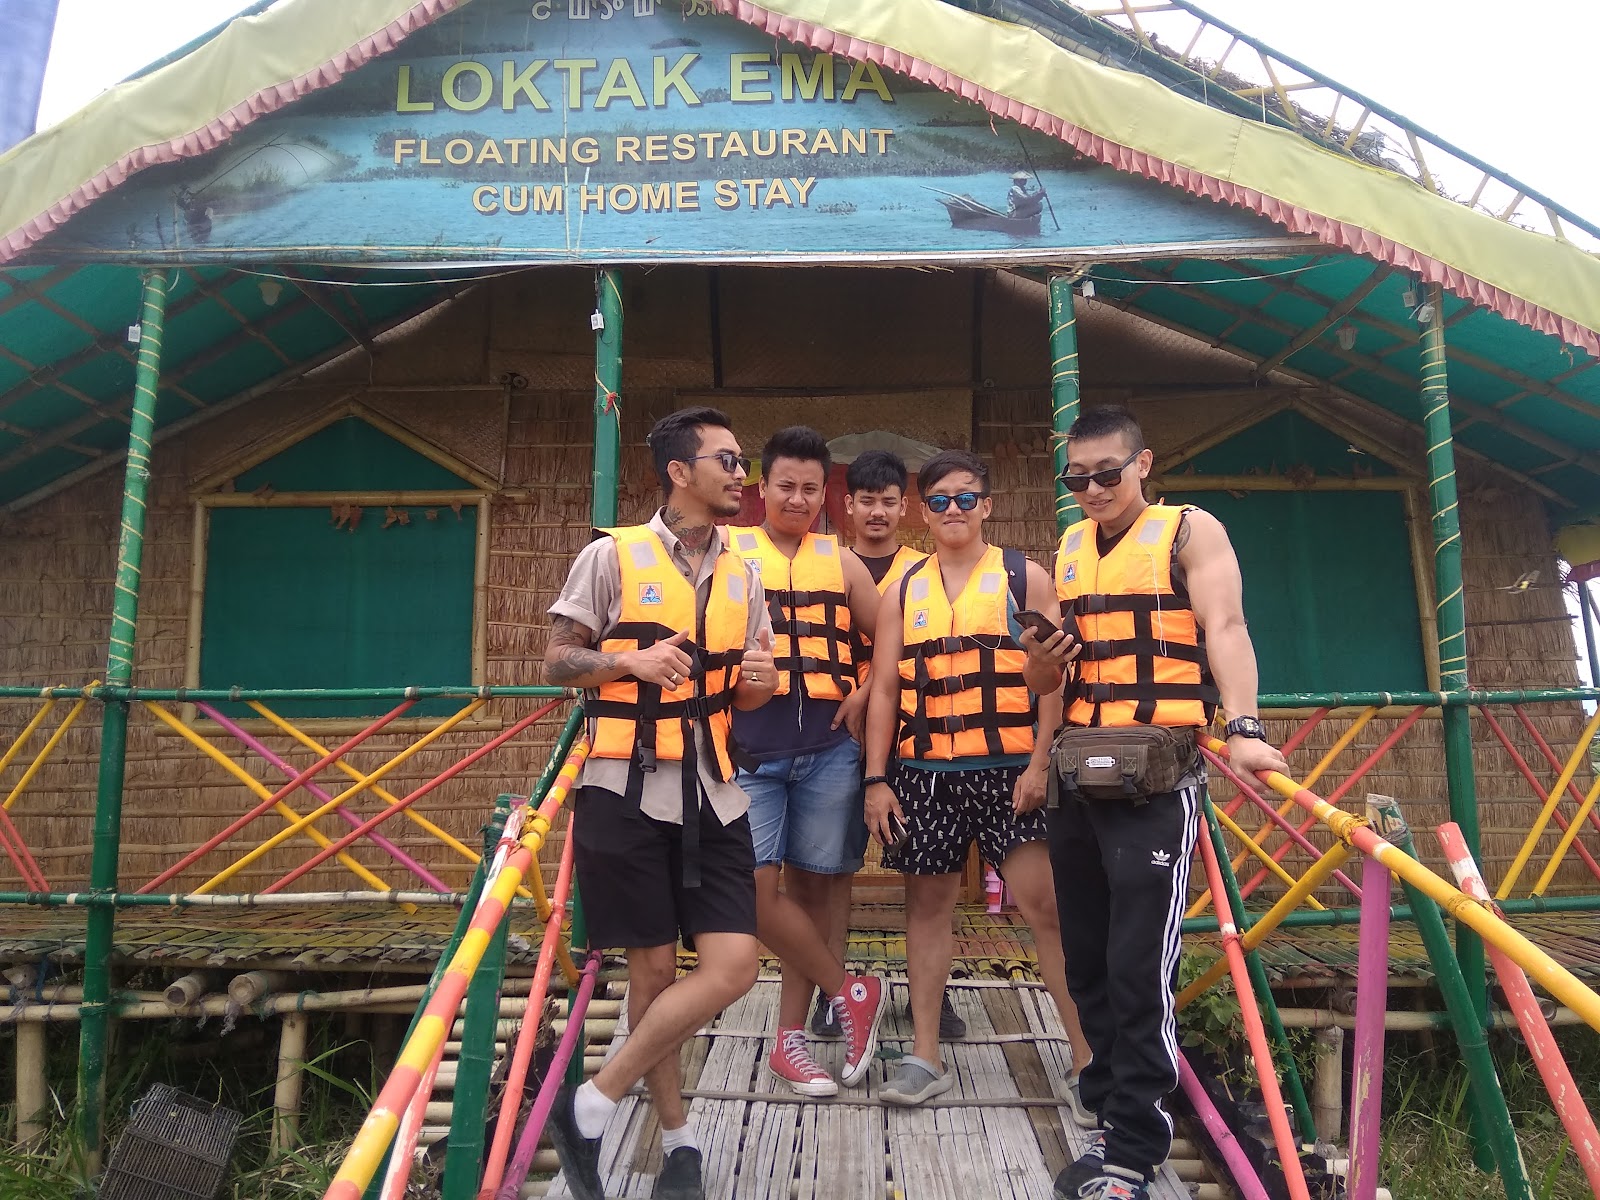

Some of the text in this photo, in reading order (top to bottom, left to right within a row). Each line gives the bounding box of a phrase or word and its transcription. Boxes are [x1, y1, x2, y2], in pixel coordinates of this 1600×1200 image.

[396, 52, 894, 113] LOKTAK EMA
[393, 128, 894, 165] FLOATING RESTAURANT
[472, 176, 816, 213] CUM HOME STAY
